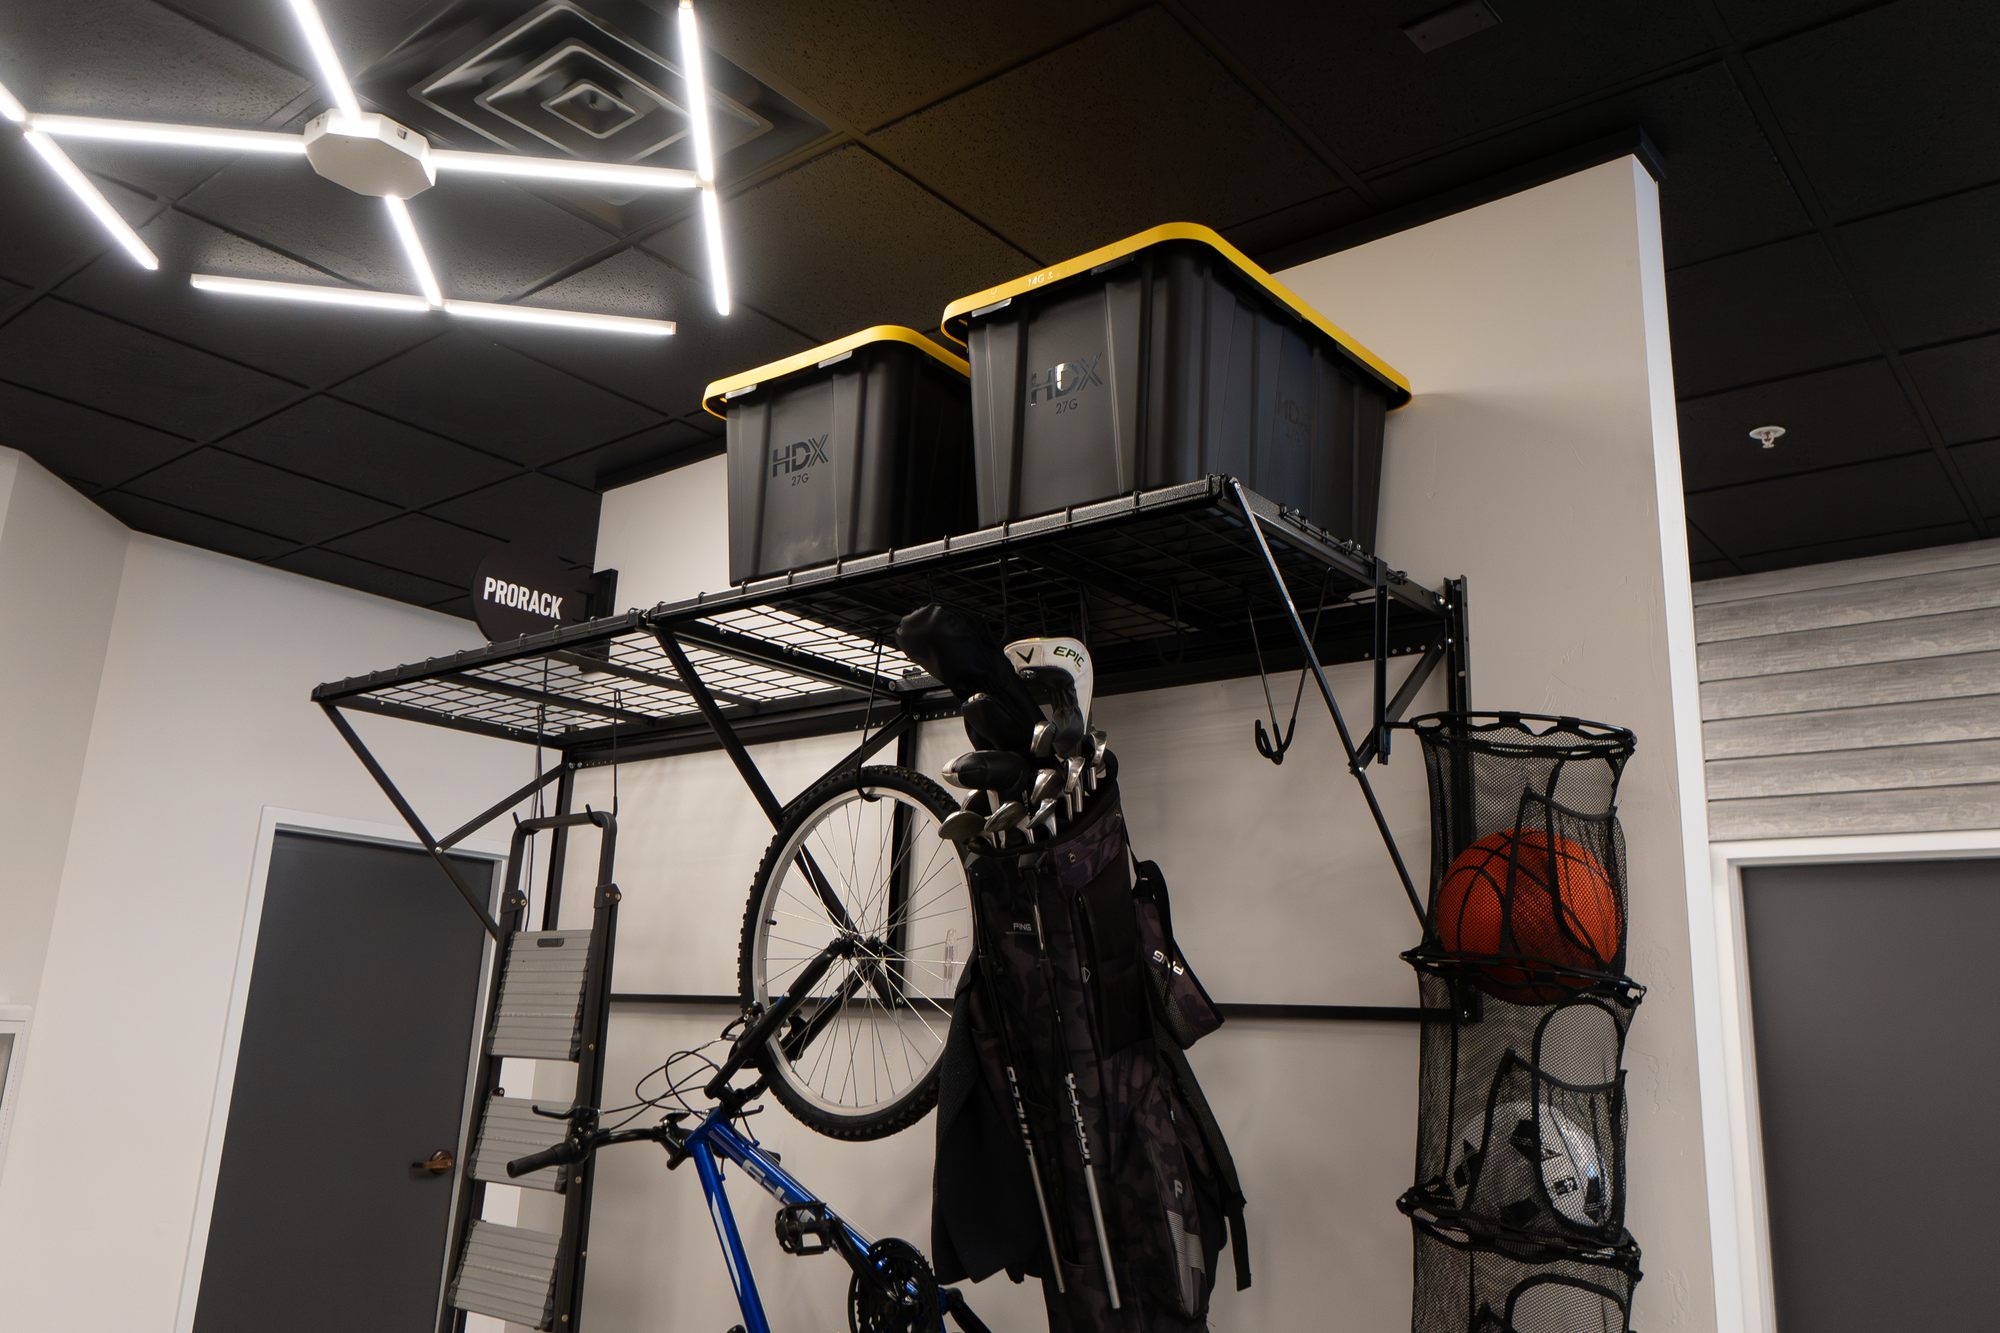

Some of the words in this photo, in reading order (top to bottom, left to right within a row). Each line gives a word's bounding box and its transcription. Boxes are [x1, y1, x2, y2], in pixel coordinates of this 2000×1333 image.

[1031, 352, 1103, 407] HDX
[1055, 399, 1078, 415] 27G
[772, 433, 829, 478] HDX
[791, 472, 809, 487] 27G
[483, 576, 563, 620] PRORACK
[1053, 646, 1085, 668] EPIC
[1012, 922, 1032, 931] PING
